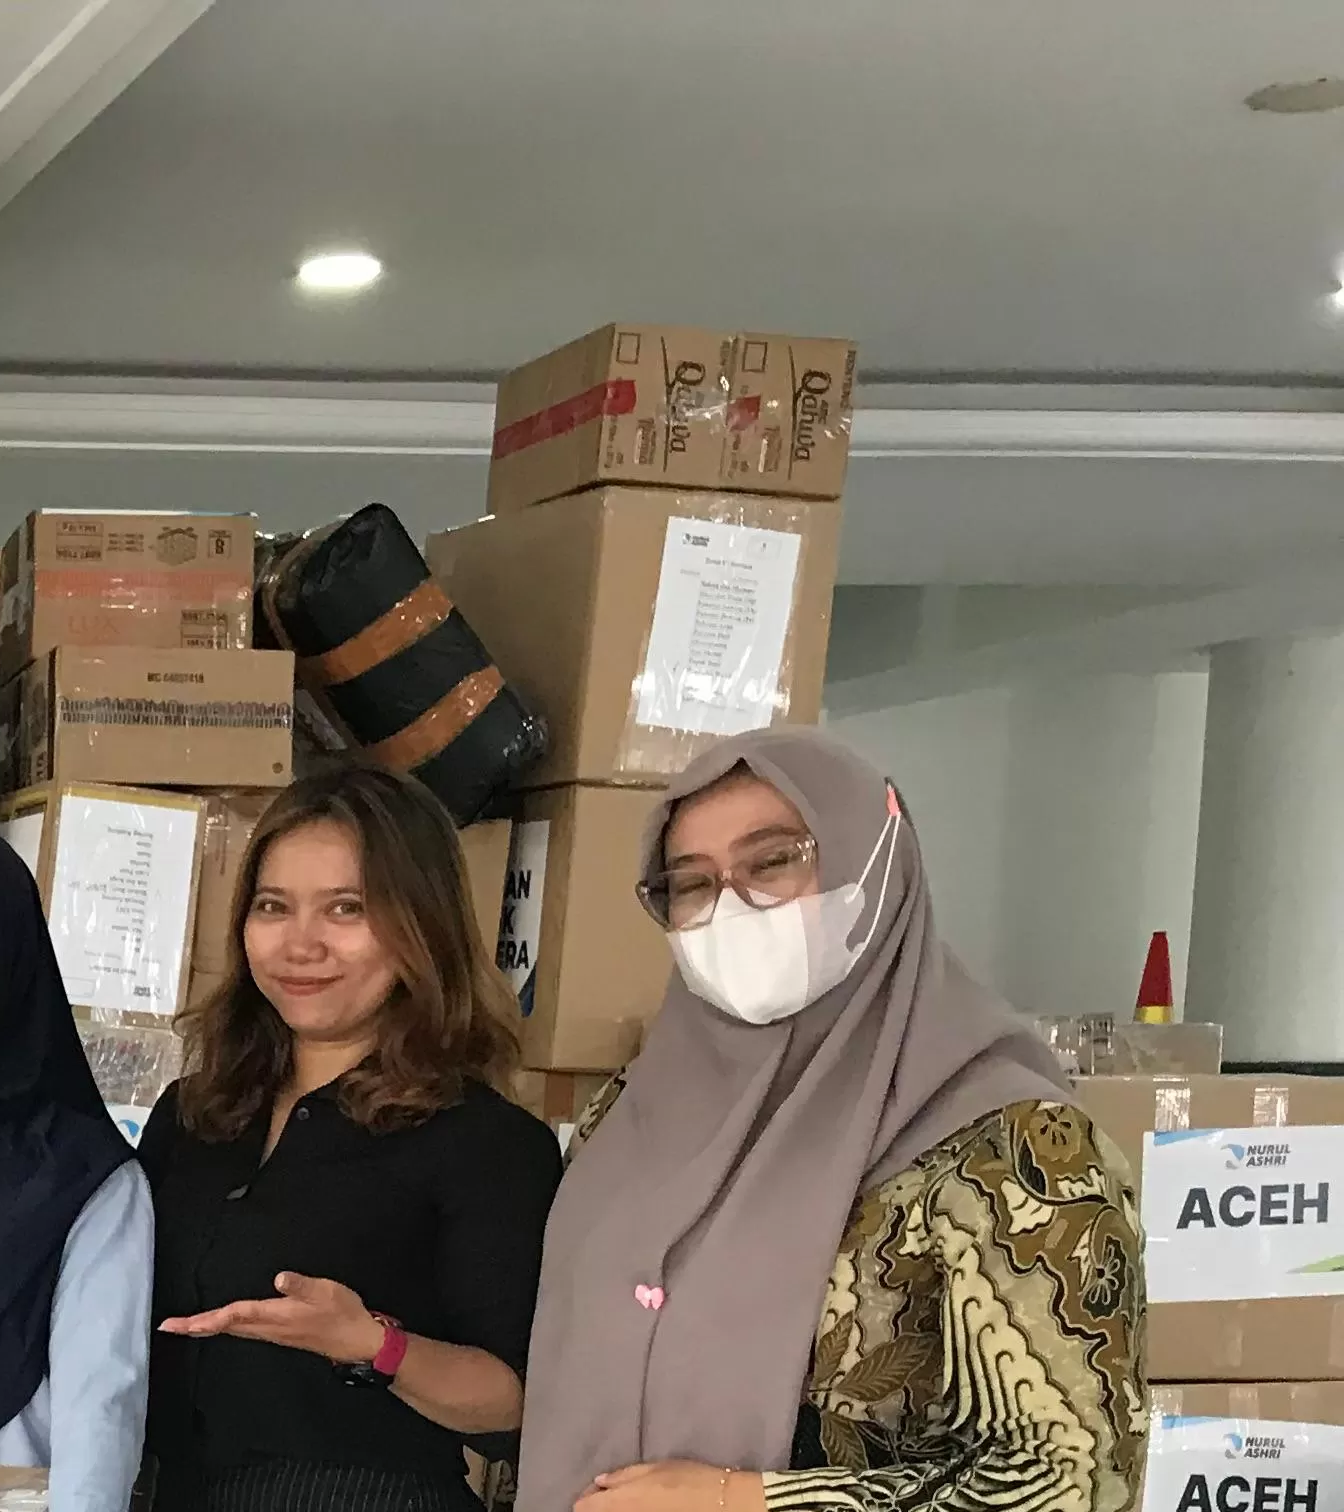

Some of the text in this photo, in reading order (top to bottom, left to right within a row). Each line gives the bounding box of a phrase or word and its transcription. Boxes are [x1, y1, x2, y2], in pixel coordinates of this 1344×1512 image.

[793, 369, 833, 463] Qahwa
[1247, 1144, 1291, 1156] NURUL
[1246, 1155, 1287, 1168] ASHRI
[1176, 1183, 1330, 1230] ACEH
[1244, 1437, 1286, 1449] NURUL
[1244, 1448, 1280, 1459] ASHRI
